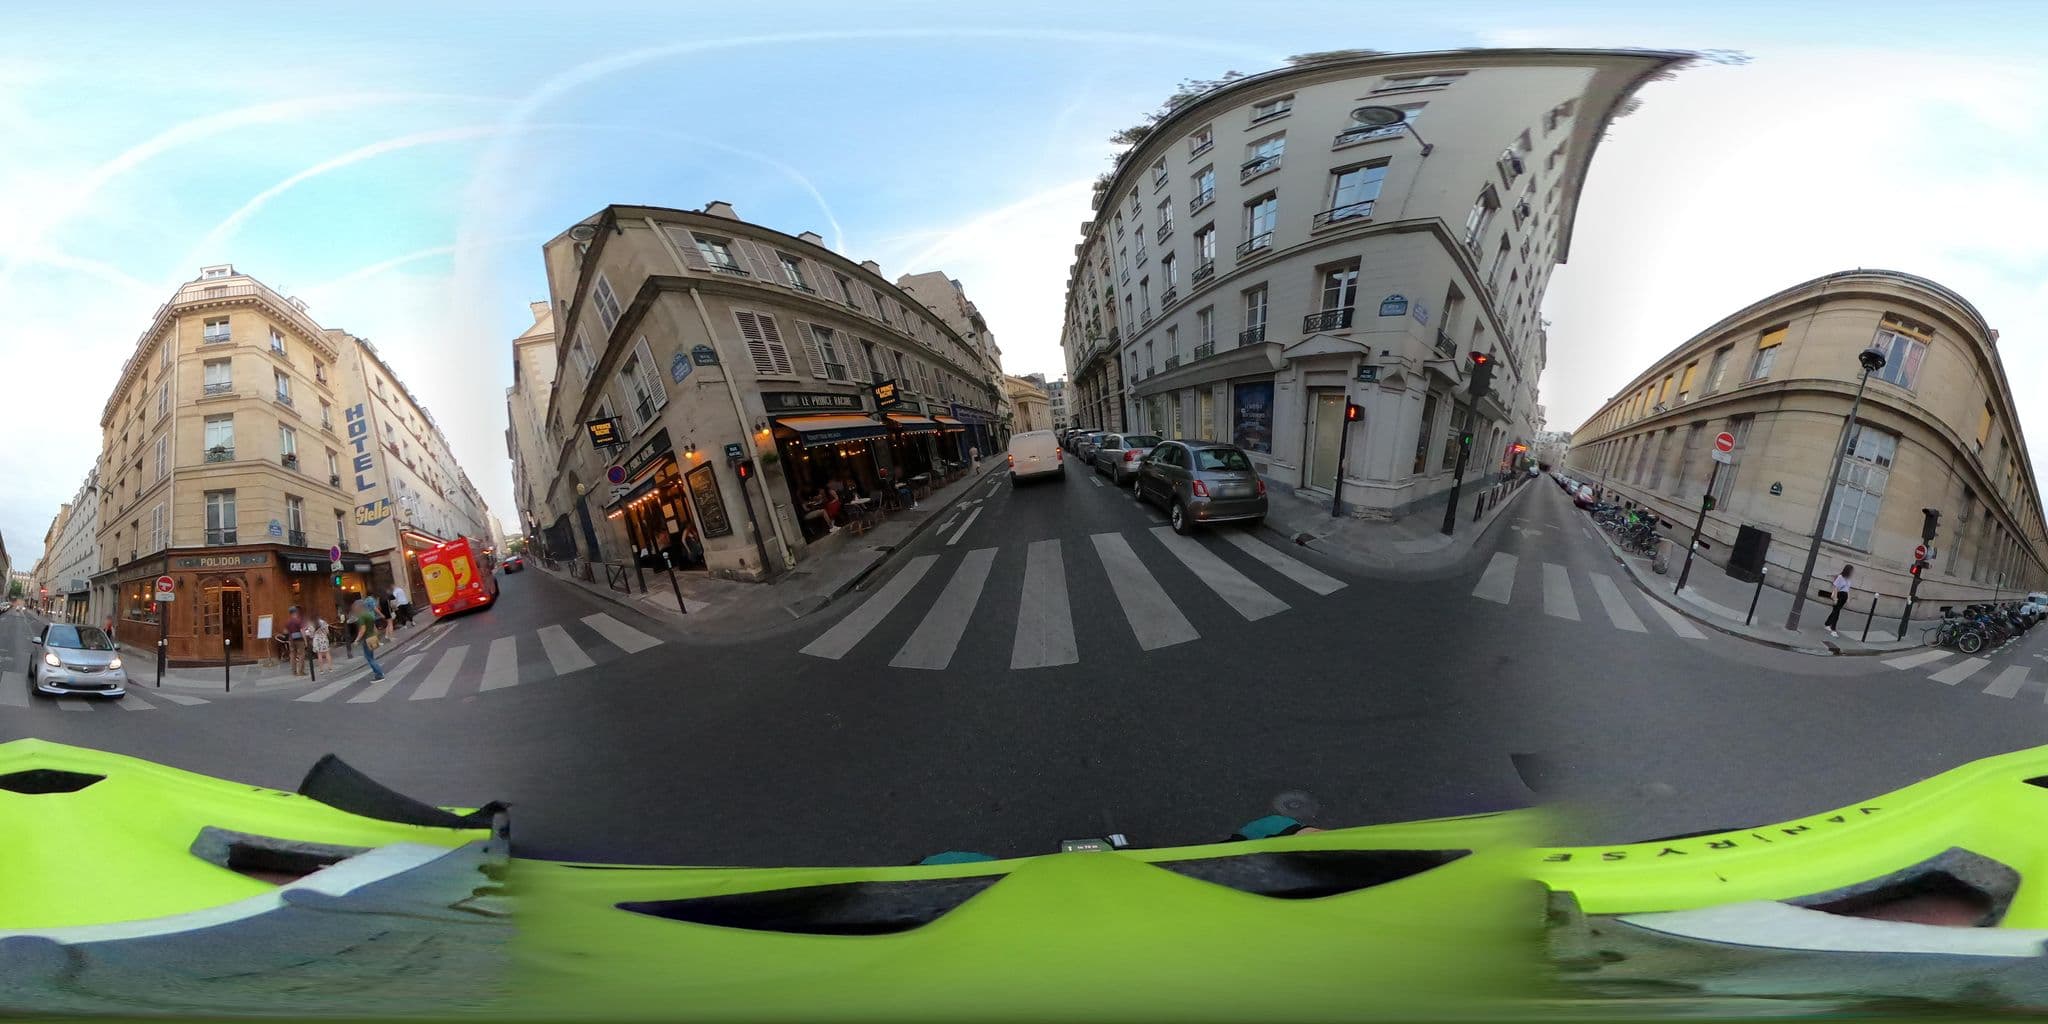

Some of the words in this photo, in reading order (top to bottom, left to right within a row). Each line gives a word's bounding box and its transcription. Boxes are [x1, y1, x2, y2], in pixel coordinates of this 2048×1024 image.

[801, 397, 810, 406] LE
[811, 396, 833, 407] PRINCE
[345, 403, 377, 492] HOTEL
[356, 500, 391, 524] Stella
[200, 555, 241, 568] POLIDOR
